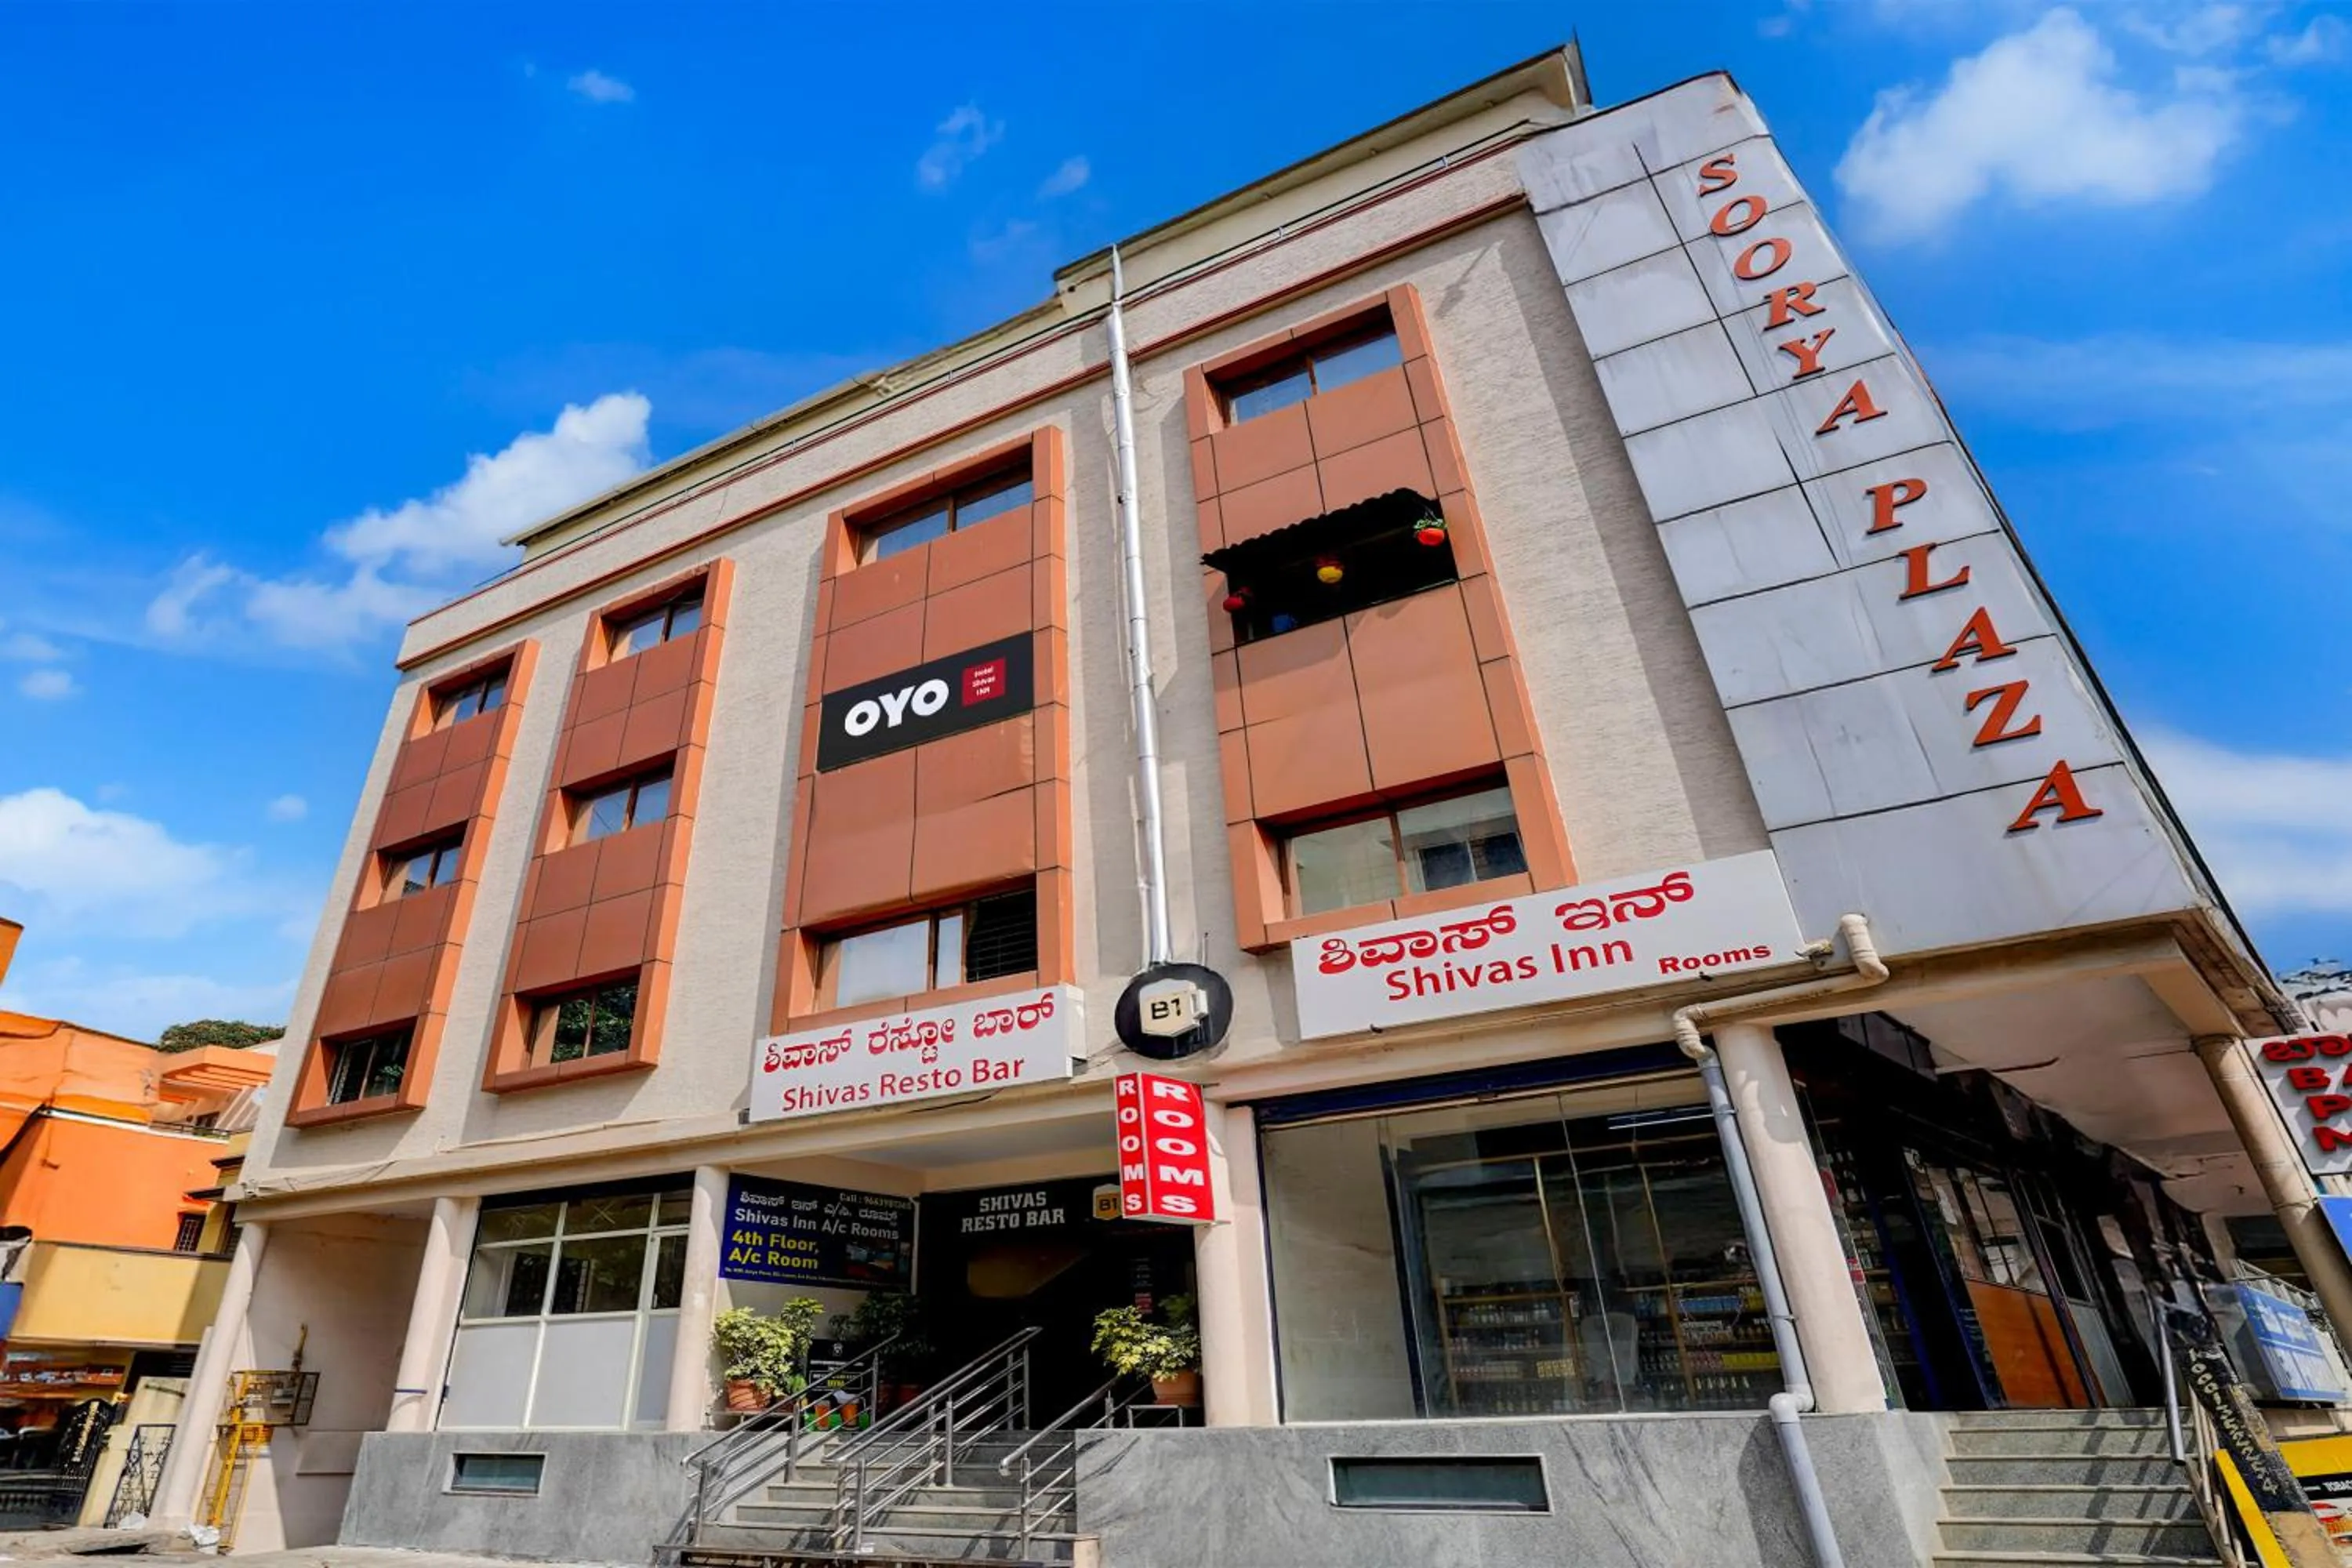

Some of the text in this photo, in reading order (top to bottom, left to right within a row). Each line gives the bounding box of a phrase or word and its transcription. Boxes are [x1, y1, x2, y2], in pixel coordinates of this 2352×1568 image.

[1697, 154, 2103, 833] SOORYA PLAZA
[844, 678, 949, 736] OYO
[1319, 870, 1694, 975] ಶಿವಾಸ್ ಇನ್
[1385, 940, 1772, 1000] Shivas Inn Rooms
[973, 992, 1054, 1038] ಬಾರ್
[1150, 997, 1181, 1019] B1
[782, 1058, 1025, 1112] Shivas Resto Bar
[1119, 1079, 1145, 1212] ROOMS
[1152, 1081, 1205, 1214] ROOMS
[735, 1208, 899, 1240] Shivas Inn A/c Rooms
[961, 1208, 1065, 1233] RESTO BAR
[979, 1191, 1047, 1213] SHIVAS
[728, 1247, 818, 1269] A/c Room
[731, 1229, 820, 1254] 4th Floor,
